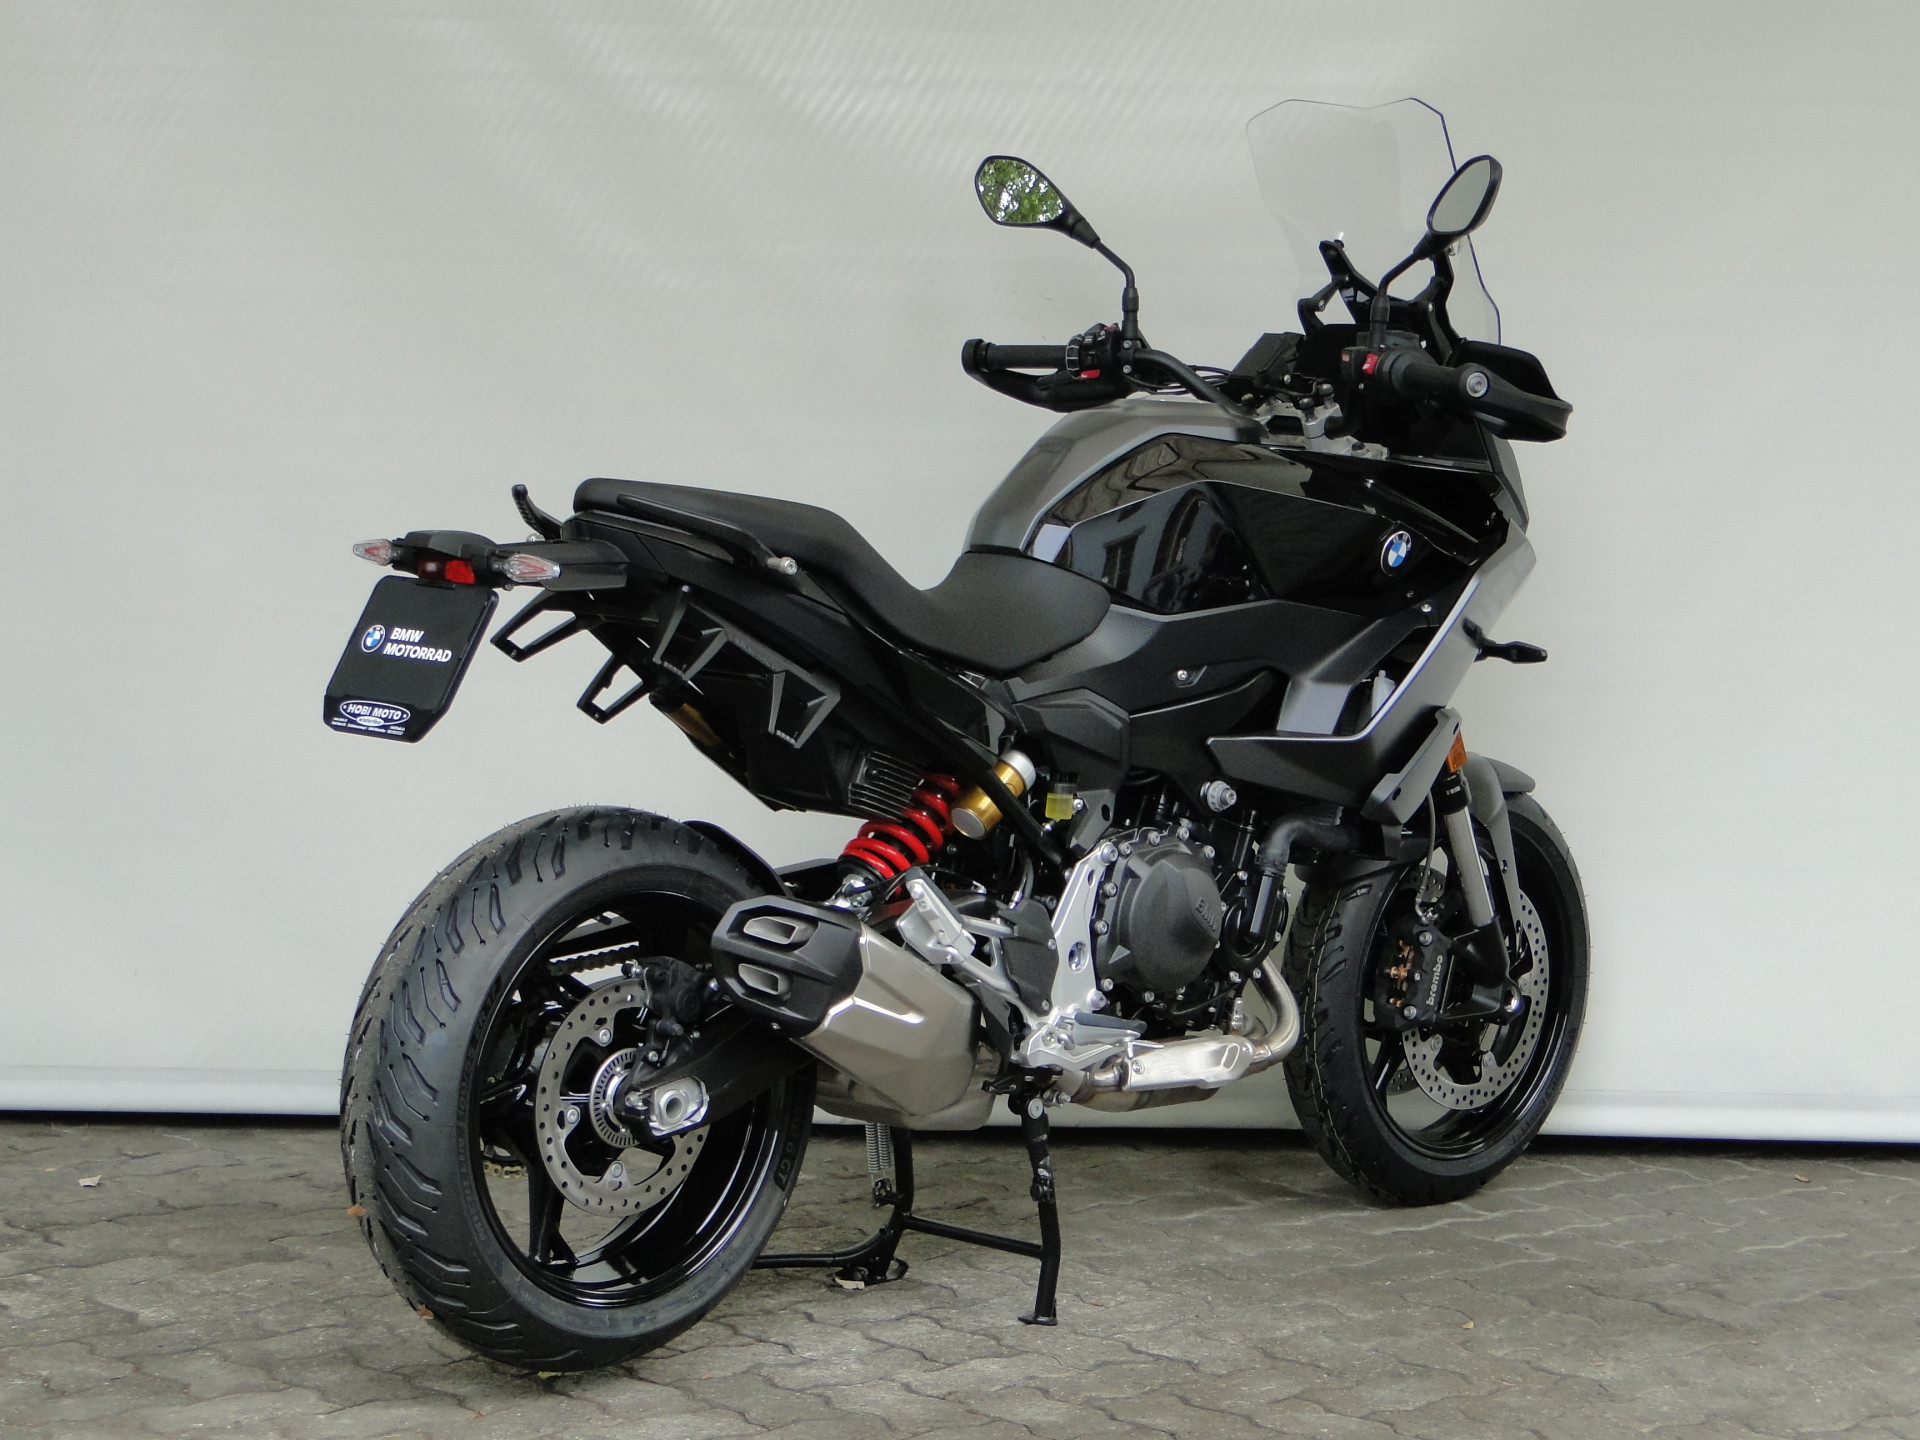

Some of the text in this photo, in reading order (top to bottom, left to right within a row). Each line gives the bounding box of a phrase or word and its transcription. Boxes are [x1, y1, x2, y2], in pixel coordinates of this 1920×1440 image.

[390, 627, 424, 643] BMW
[383, 643, 453, 663] MOTORRAD
[346, 703, 402, 720] HOBI MOTO
